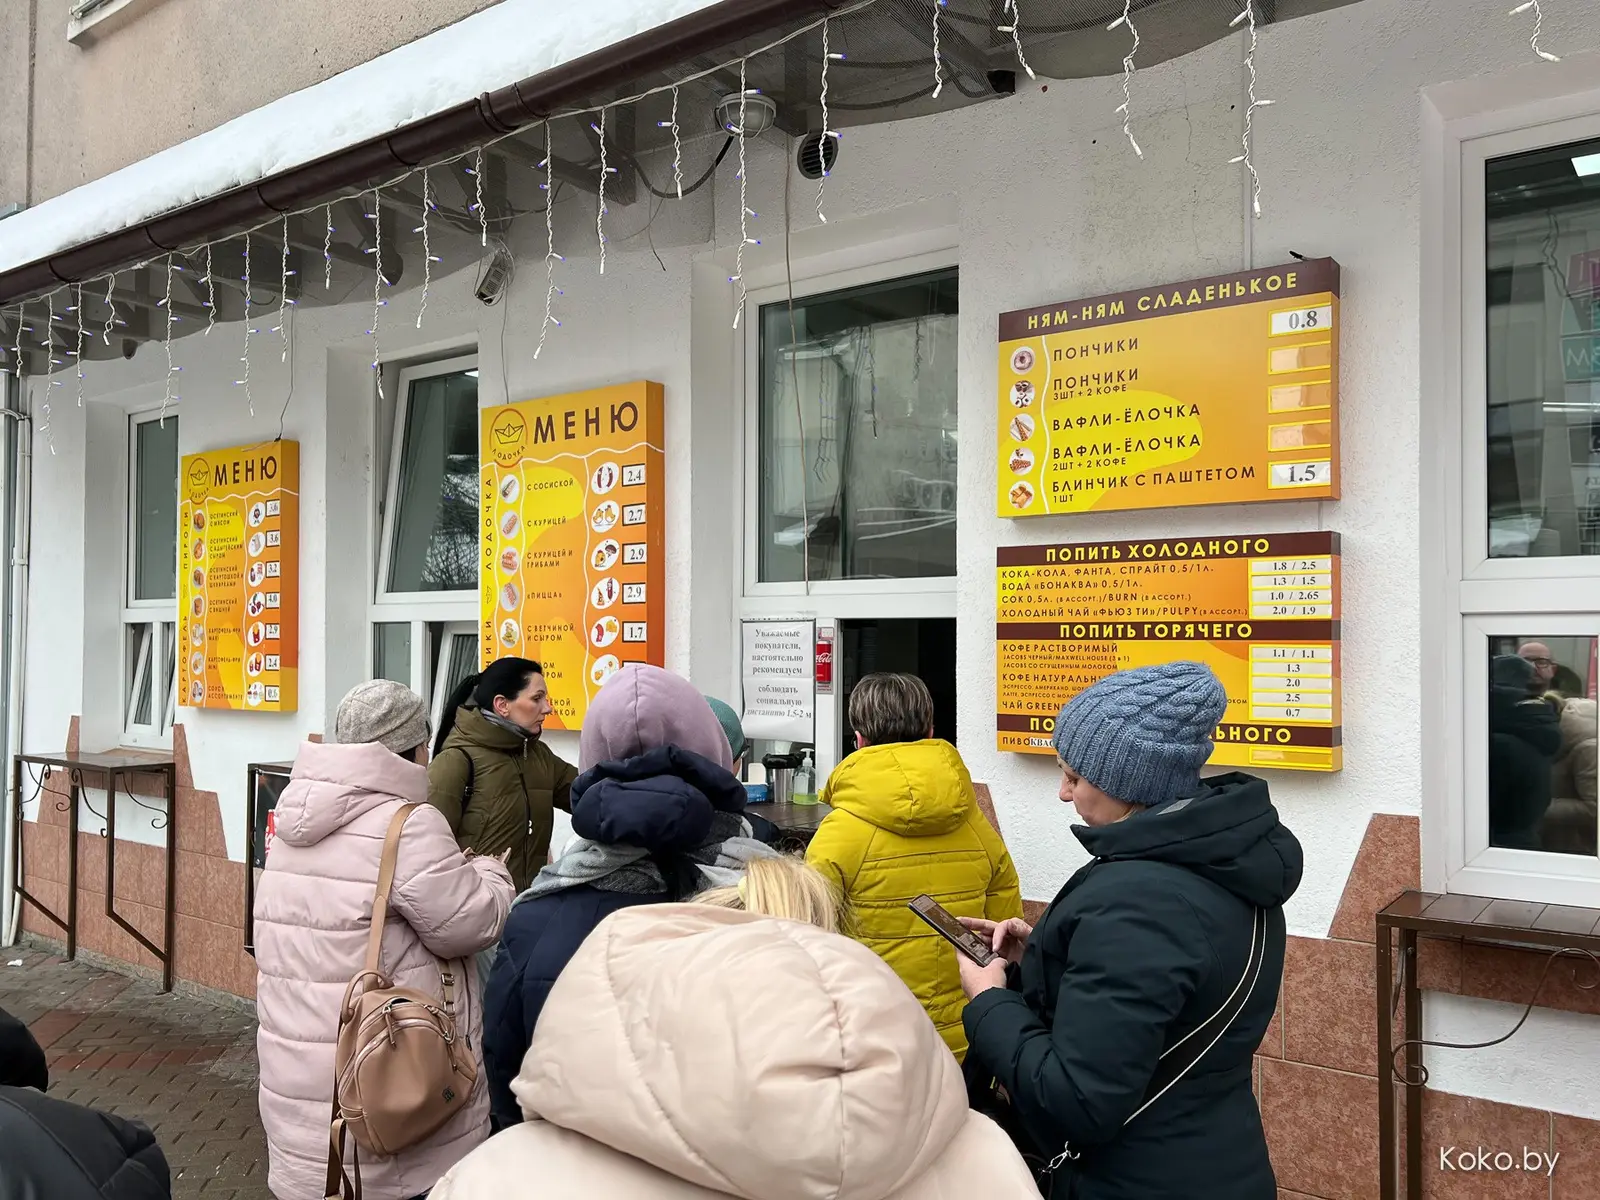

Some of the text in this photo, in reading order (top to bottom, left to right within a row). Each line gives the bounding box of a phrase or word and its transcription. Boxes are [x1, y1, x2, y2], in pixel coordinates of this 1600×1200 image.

[1027, 272, 1298, 330] НЯМ-НЯМ СЛАДЕНЬКОЕ
[1288, 310, 1318, 330] 0.8
[1053, 338, 1139, 361] ПОНЧИКИ
[1053, 368, 1139, 390] ПОНЧИКИ
[1053, 391, 1074, 401] 3ШТ
[1087, 388, 1092, 397] 2
[1096, 384, 1127, 395] КОФЕ
[1053, 403, 1201, 431] ВАФЛИ-ЁЛОЧКА
[533, 401, 639, 445] МЕНЮ
[1053, 434, 1201, 459] ВАФЛИ-ЁЛОЧКА
[492, 445, 526, 460] ЛОДОЧКА
[1053, 462, 1074, 472] 2ШТ
[1087, 459, 1092, 468] 2
[1096, 457, 1127, 467] КОФЕ
[214, 456, 277, 487] МЕНЮ
[628, 469, 642, 482] 2.4
[1288, 464, 1316, 483] 1.5
[527, 478, 574, 491] С СОСИСКОЙ
[1052, 466, 1255, 493] БЛИНЧИК С ПАШТЕТОМ
[1053, 494, 1074, 503] 1ШТ
[628, 509, 643, 521] 2.7
[527, 515, 567, 527] С КУРИЦЕЙ
[527, 551, 532, 559] С
[534, 548, 566, 559] КУРИЦЕЙ
[630, 547, 644, 560] 2.9
[1046, 538, 1270, 562] ПОПИТЬ ХОЛОДНОГО
[526, 560, 560, 569] ГРИБАМИ
[1273, 562, 1287, 571] 1.8
[1301, 561, 1316, 570] 2.5
[1002, 568, 1071, 578] КОКА-КОЛА,
[1074, 567, 1116, 576] ФАНТА,
[1120, 563, 1166, 575] СПРАЙТ
[1002, 582, 1031, 591] ВОДА
[1035, 580, 1098, 590] «БОНАКВА»
[1273, 577, 1287, 586] 1.3
[1302, 576, 1316, 585] 1.5
[627, 586, 642, 598] 2.9
[1270, 592, 1284, 600] 1.0
[1298, 591, 1319, 600] 2.65
[1002, 595, 1024, 604] СОК
[1002, 607, 1064, 618] ХОЛОДНЫЙ
[1067, 607, 1089, 617] ЧАЙ
[1273, 606, 1287, 615] 2.0
[1302, 606, 1316, 615] 1.9
[534, 622, 574, 632] ВЕТЧИНОЙ
[629, 627, 643, 638] 1.7
[1060, 623, 1252, 639] ПОПИТЬ ГОРЯЧЕГО
[527, 634, 562, 642] И СЫРОМ
[755, 628, 801, 638] Уважаемые
[754, 643, 801, 652] покупатели,
[1002, 643, 1118, 653] КОФЕ РАСТВОРИМЫЙ
[1273, 649, 1286, 657] 1.1
[1302, 650, 1315, 658] 1.1
[752, 666, 803, 676] рекомендуем
[1287, 664, 1301, 672] 1.3
[1002, 673, 1030, 682] КОФЕ
[1285, 679, 1301, 687] 2.0
[758, 684, 799, 694] соблюдать
[756, 697, 802, 707] социальную
[1285, 693, 1301, 702] 2.5
[1002, 700, 1023, 709] ЧАЙ
[1285, 708, 1301, 717] 0.7
[1002, 736, 1030, 746] ПИВО
